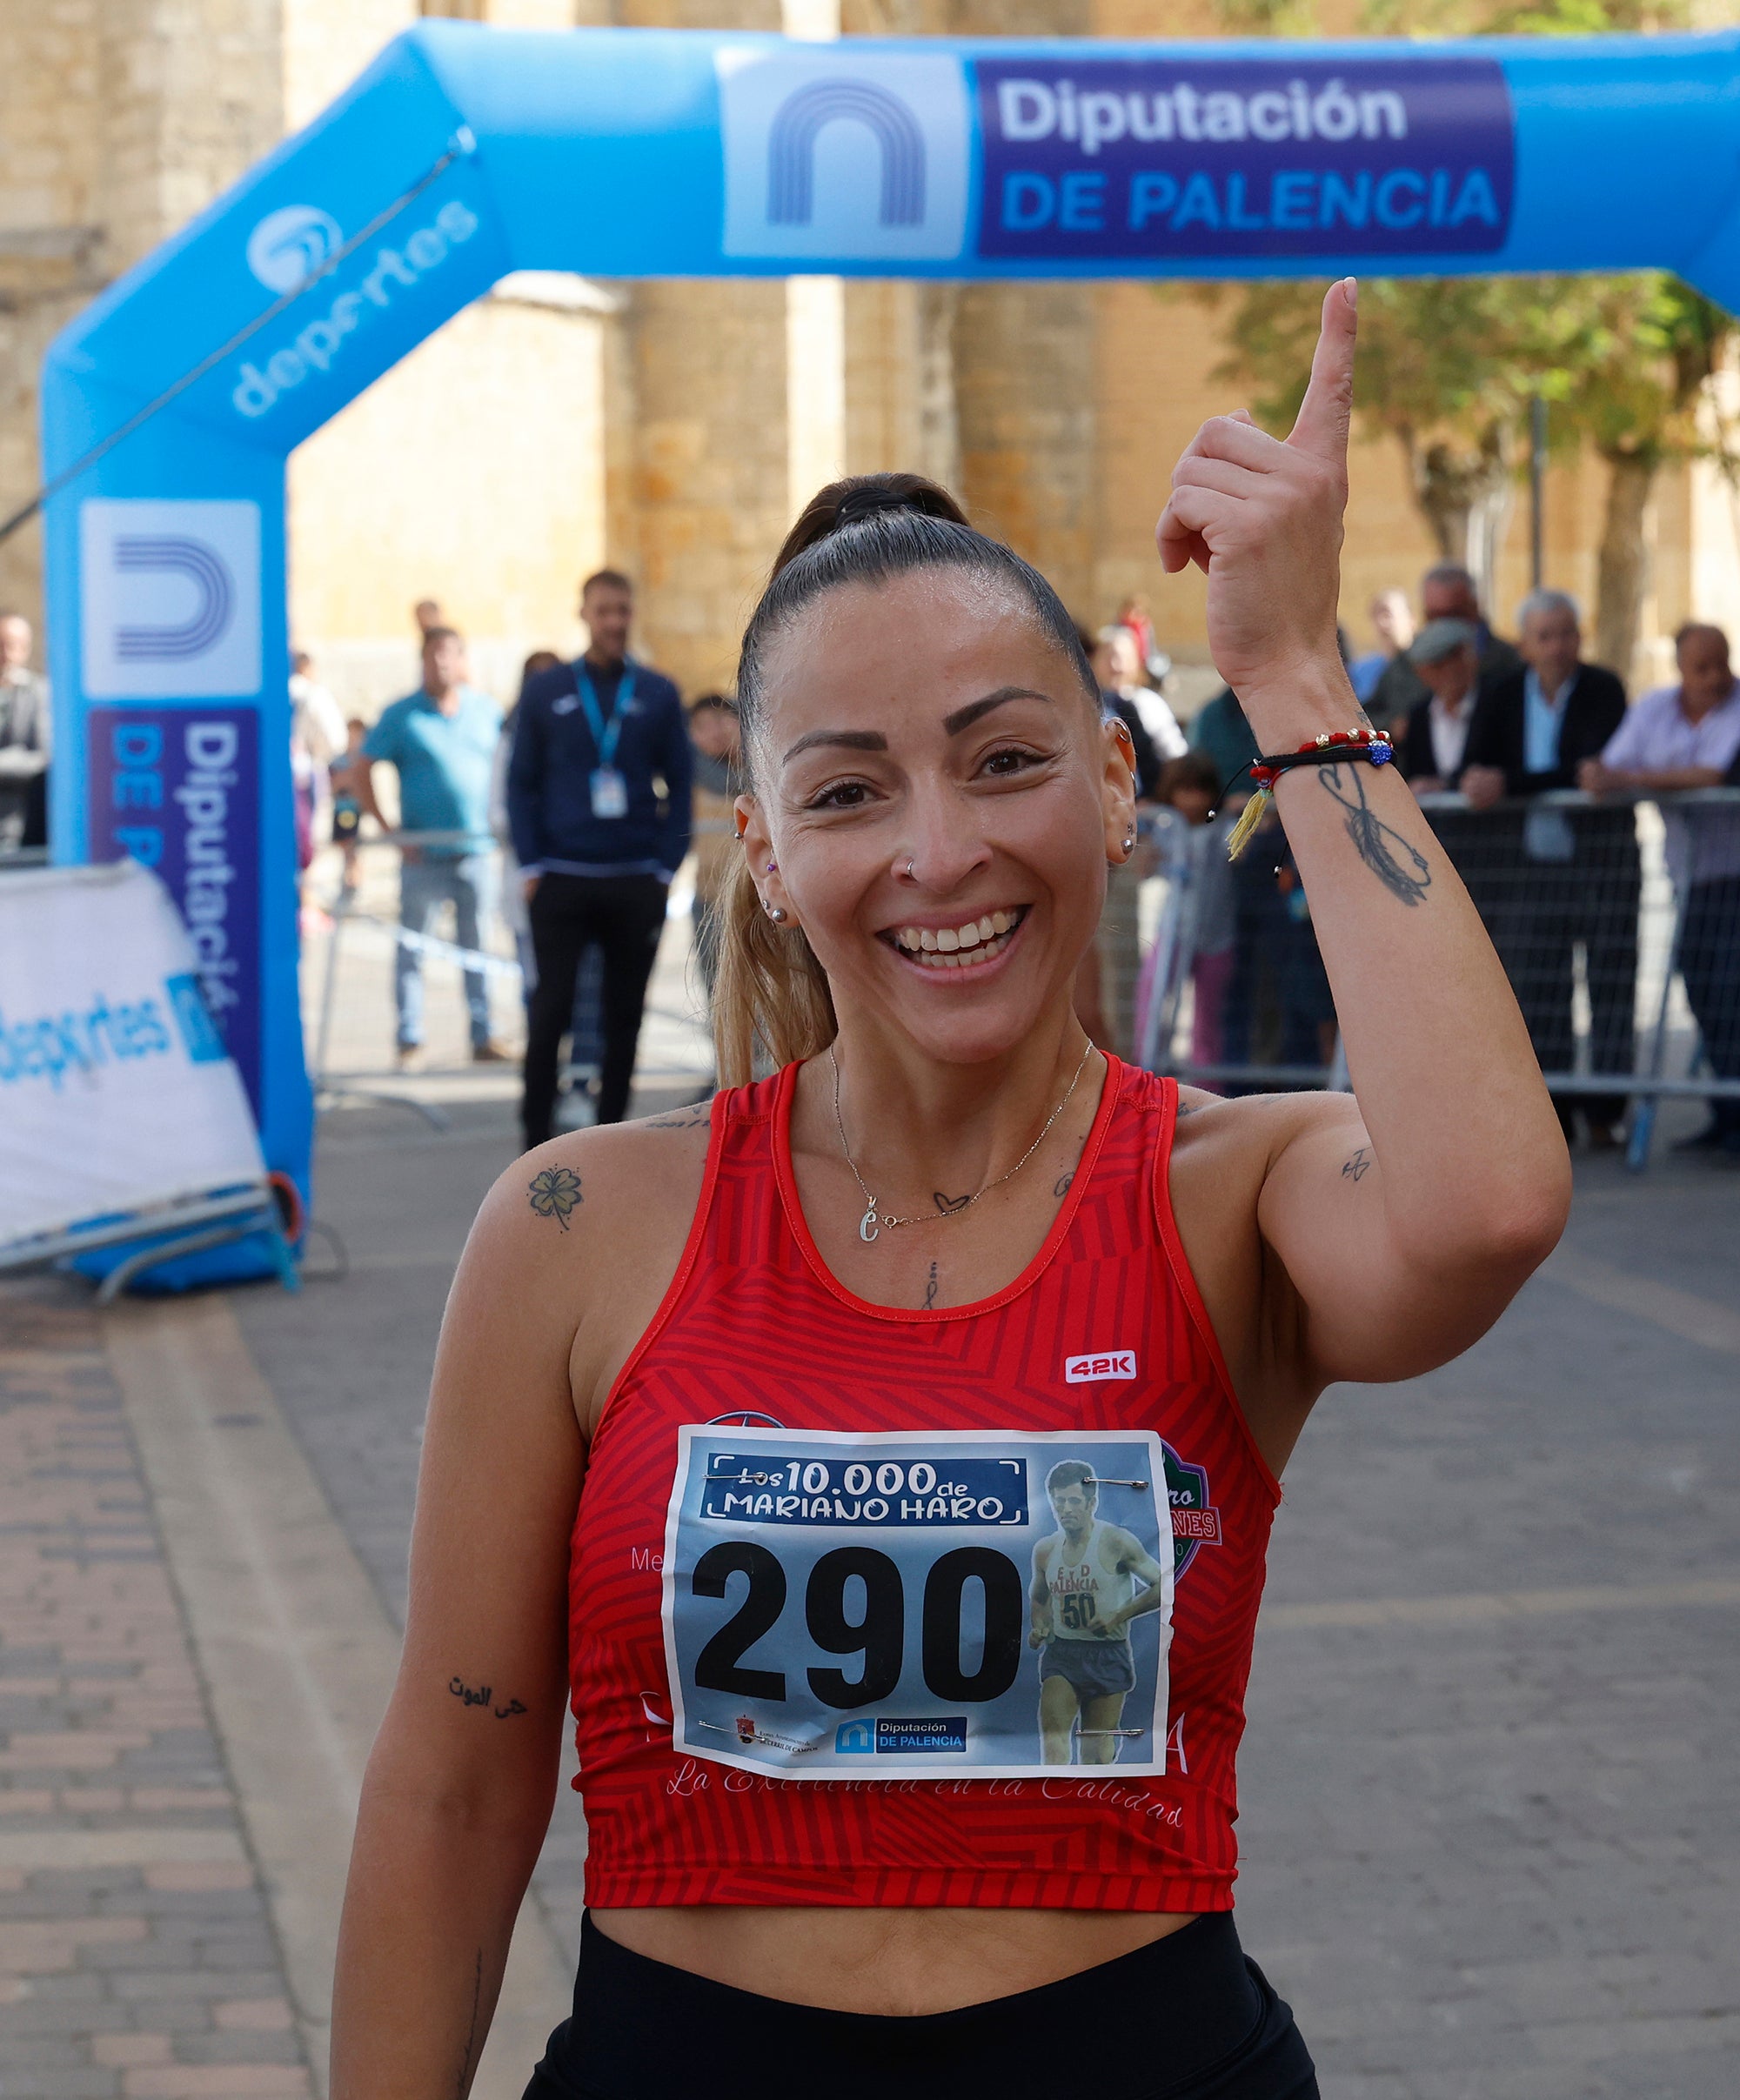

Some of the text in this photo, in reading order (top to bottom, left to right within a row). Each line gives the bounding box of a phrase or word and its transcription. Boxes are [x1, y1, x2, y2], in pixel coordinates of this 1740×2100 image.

[998, 77, 1407, 155] Diputación
[1002, 168, 1500, 231] DE PALENCIA
[232, 200, 478, 418] deportes
[113, 723, 164, 809] DE
[1071, 1357, 1130, 1375] 42K
[738, 1461, 967, 1497] Los 10.000 de
[723, 1492, 1003, 1521] MARIANO HARO
[692, 1541, 1023, 1709] 290
[1063, 1593, 1095, 1629] 50
[880, 1722, 947, 1733] Diputación
[880, 1736, 962, 1747] DE PALENCIA
[666, 1758, 709, 1796] La
